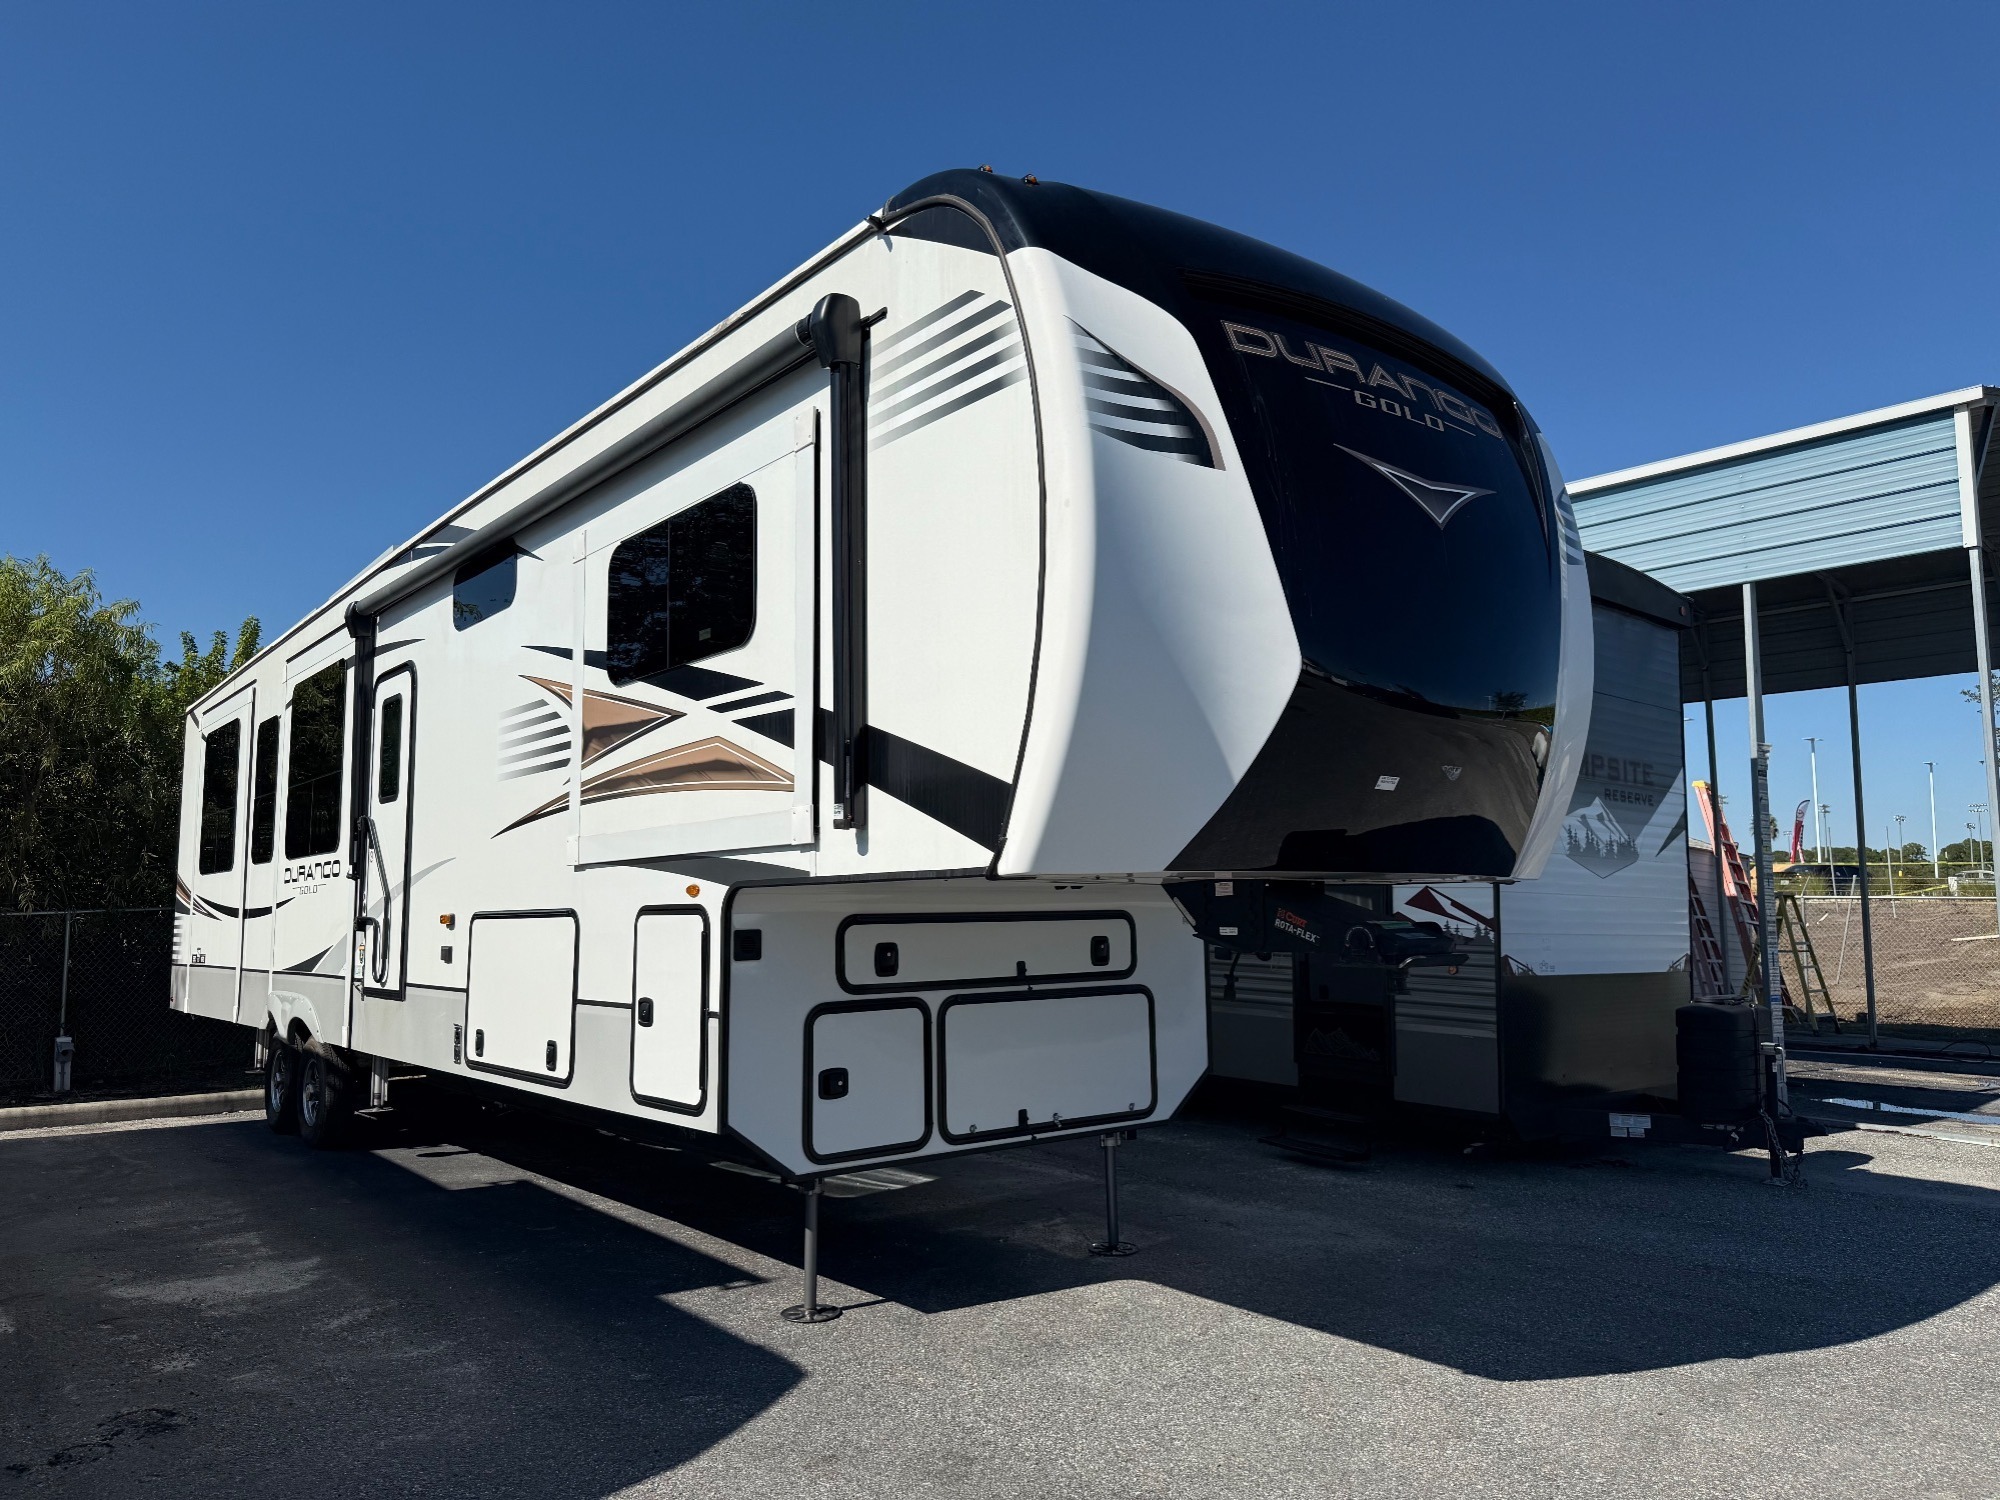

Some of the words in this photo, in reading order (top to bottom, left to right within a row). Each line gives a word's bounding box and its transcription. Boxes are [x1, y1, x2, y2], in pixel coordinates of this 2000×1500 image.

[1220, 319, 1503, 440] DURANGO
[1354, 390, 1445, 432] GOLD
[1604, 787, 1655, 807] RESERVE
[284, 859, 341, 884] DURANGO
[299, 884, 318, 895] GOLD
